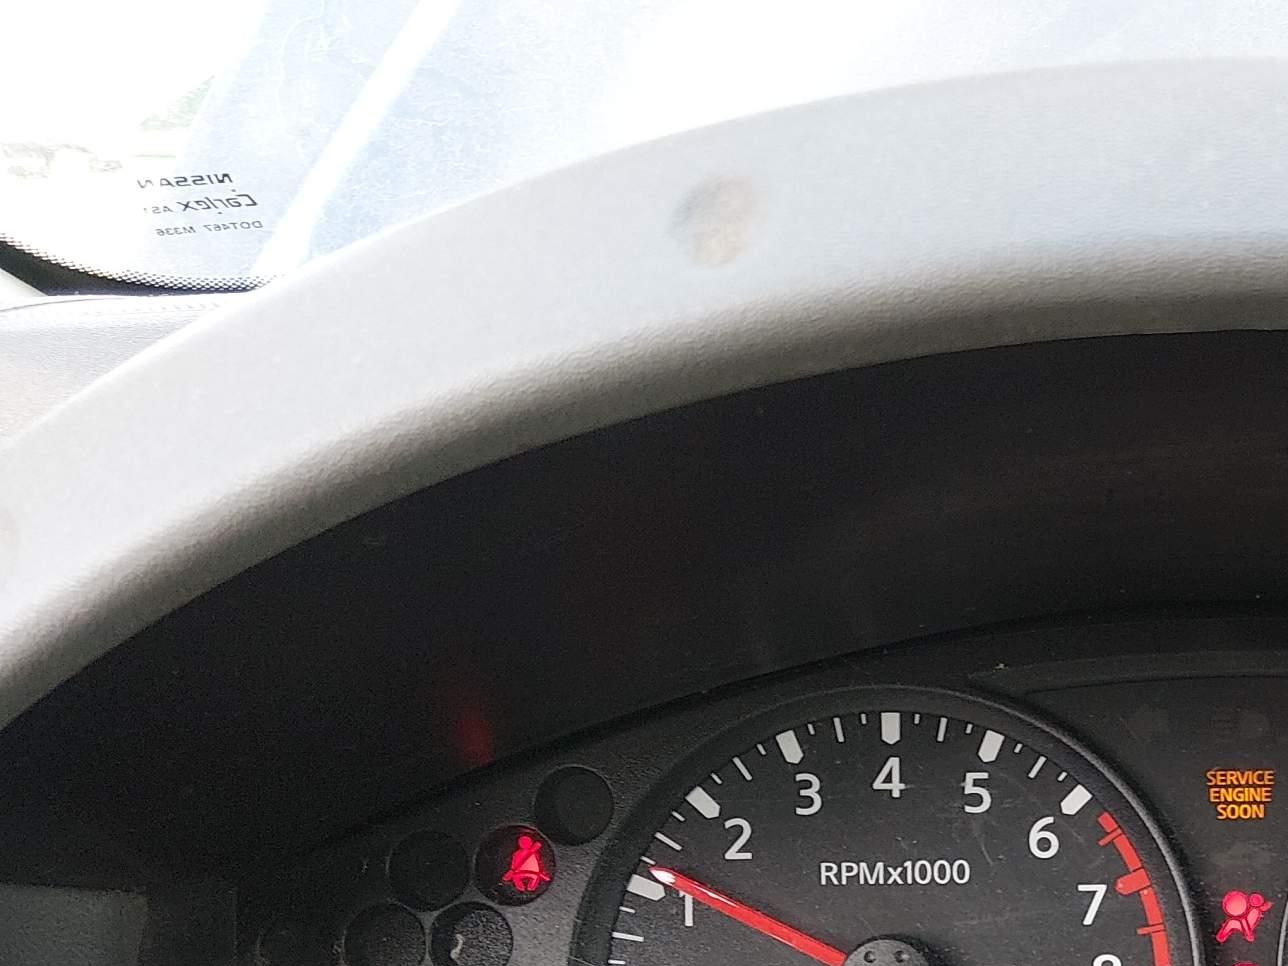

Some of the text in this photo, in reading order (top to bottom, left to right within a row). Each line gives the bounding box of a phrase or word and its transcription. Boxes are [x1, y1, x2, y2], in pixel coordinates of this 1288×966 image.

[795, 773, 822, 816] 3
[872, 757, 906, 798] 4
[961, 772, 992, 814] 5
[1207, 770, 1274, 786] SERVICE
[1209, 787, 1271, 802] ENGINE
[1217, 803, 1265, 820] SOON
[724, 817, 753, 860] 2
[1028, 816, 1060, 859] 6
[820, 859, 971, 886] RPMx1000
[1077, 883, 1108, 926] 7
